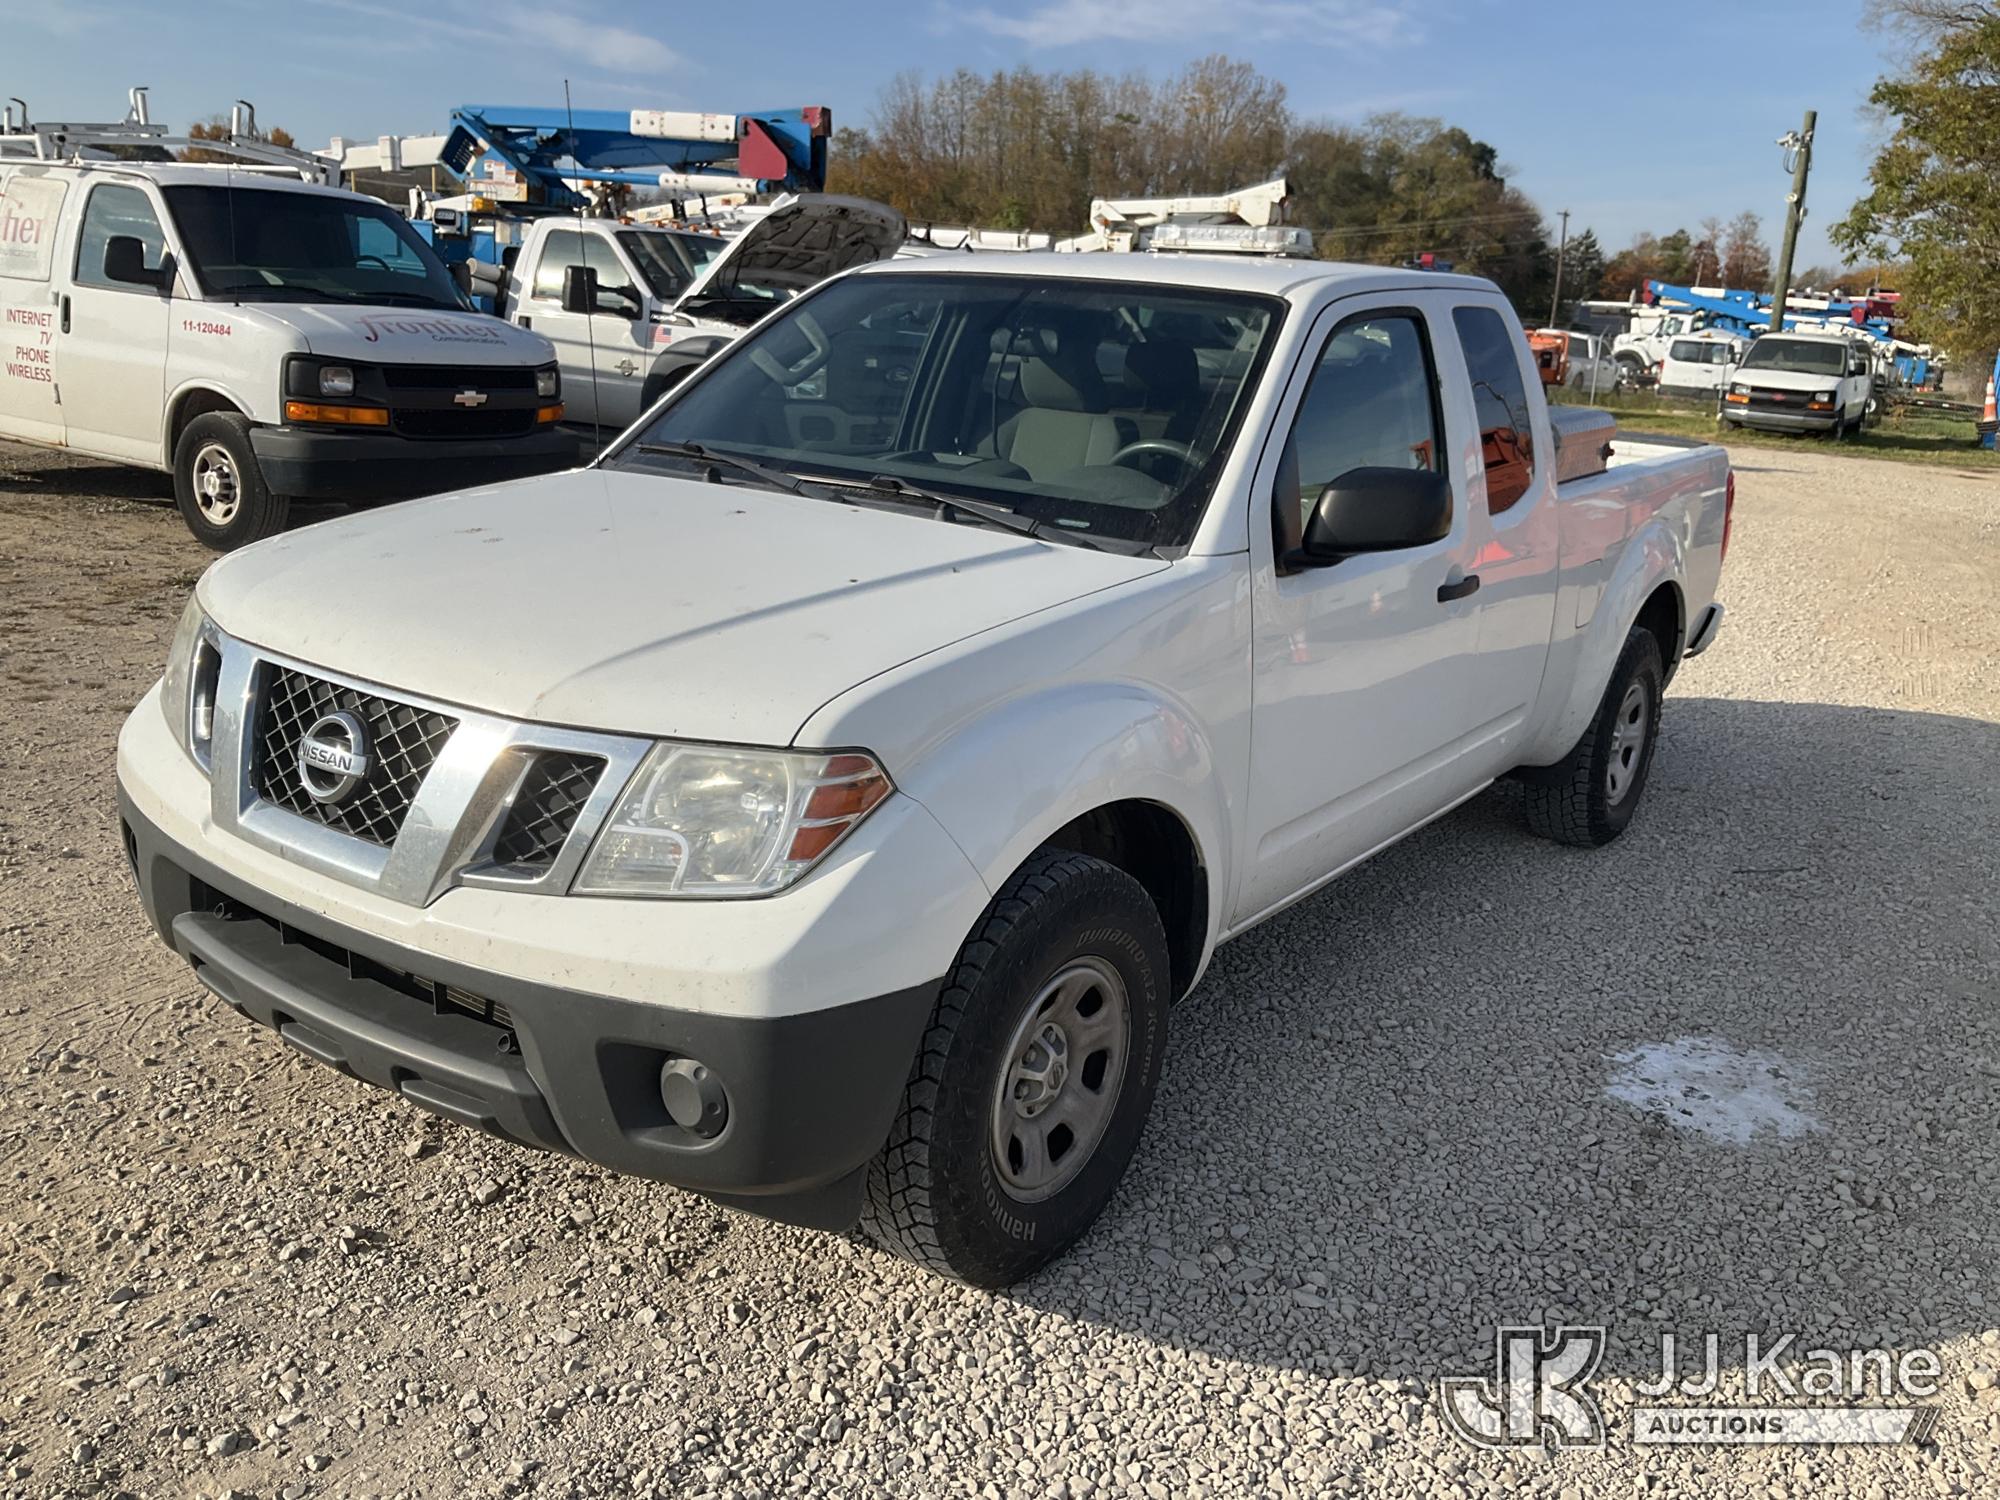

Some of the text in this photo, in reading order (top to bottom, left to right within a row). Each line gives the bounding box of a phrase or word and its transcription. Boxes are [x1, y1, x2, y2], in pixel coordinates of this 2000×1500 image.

[6, 308, 53, 328] INTERNET
[183, 319, 232, 337] 11-120484
[39, 330, 53, 346] TV
[15, 345, 50, 364] PHONE
[6, 362, 52, 382] WIRELESS
[301, 742, 353, 771] NISSAN
